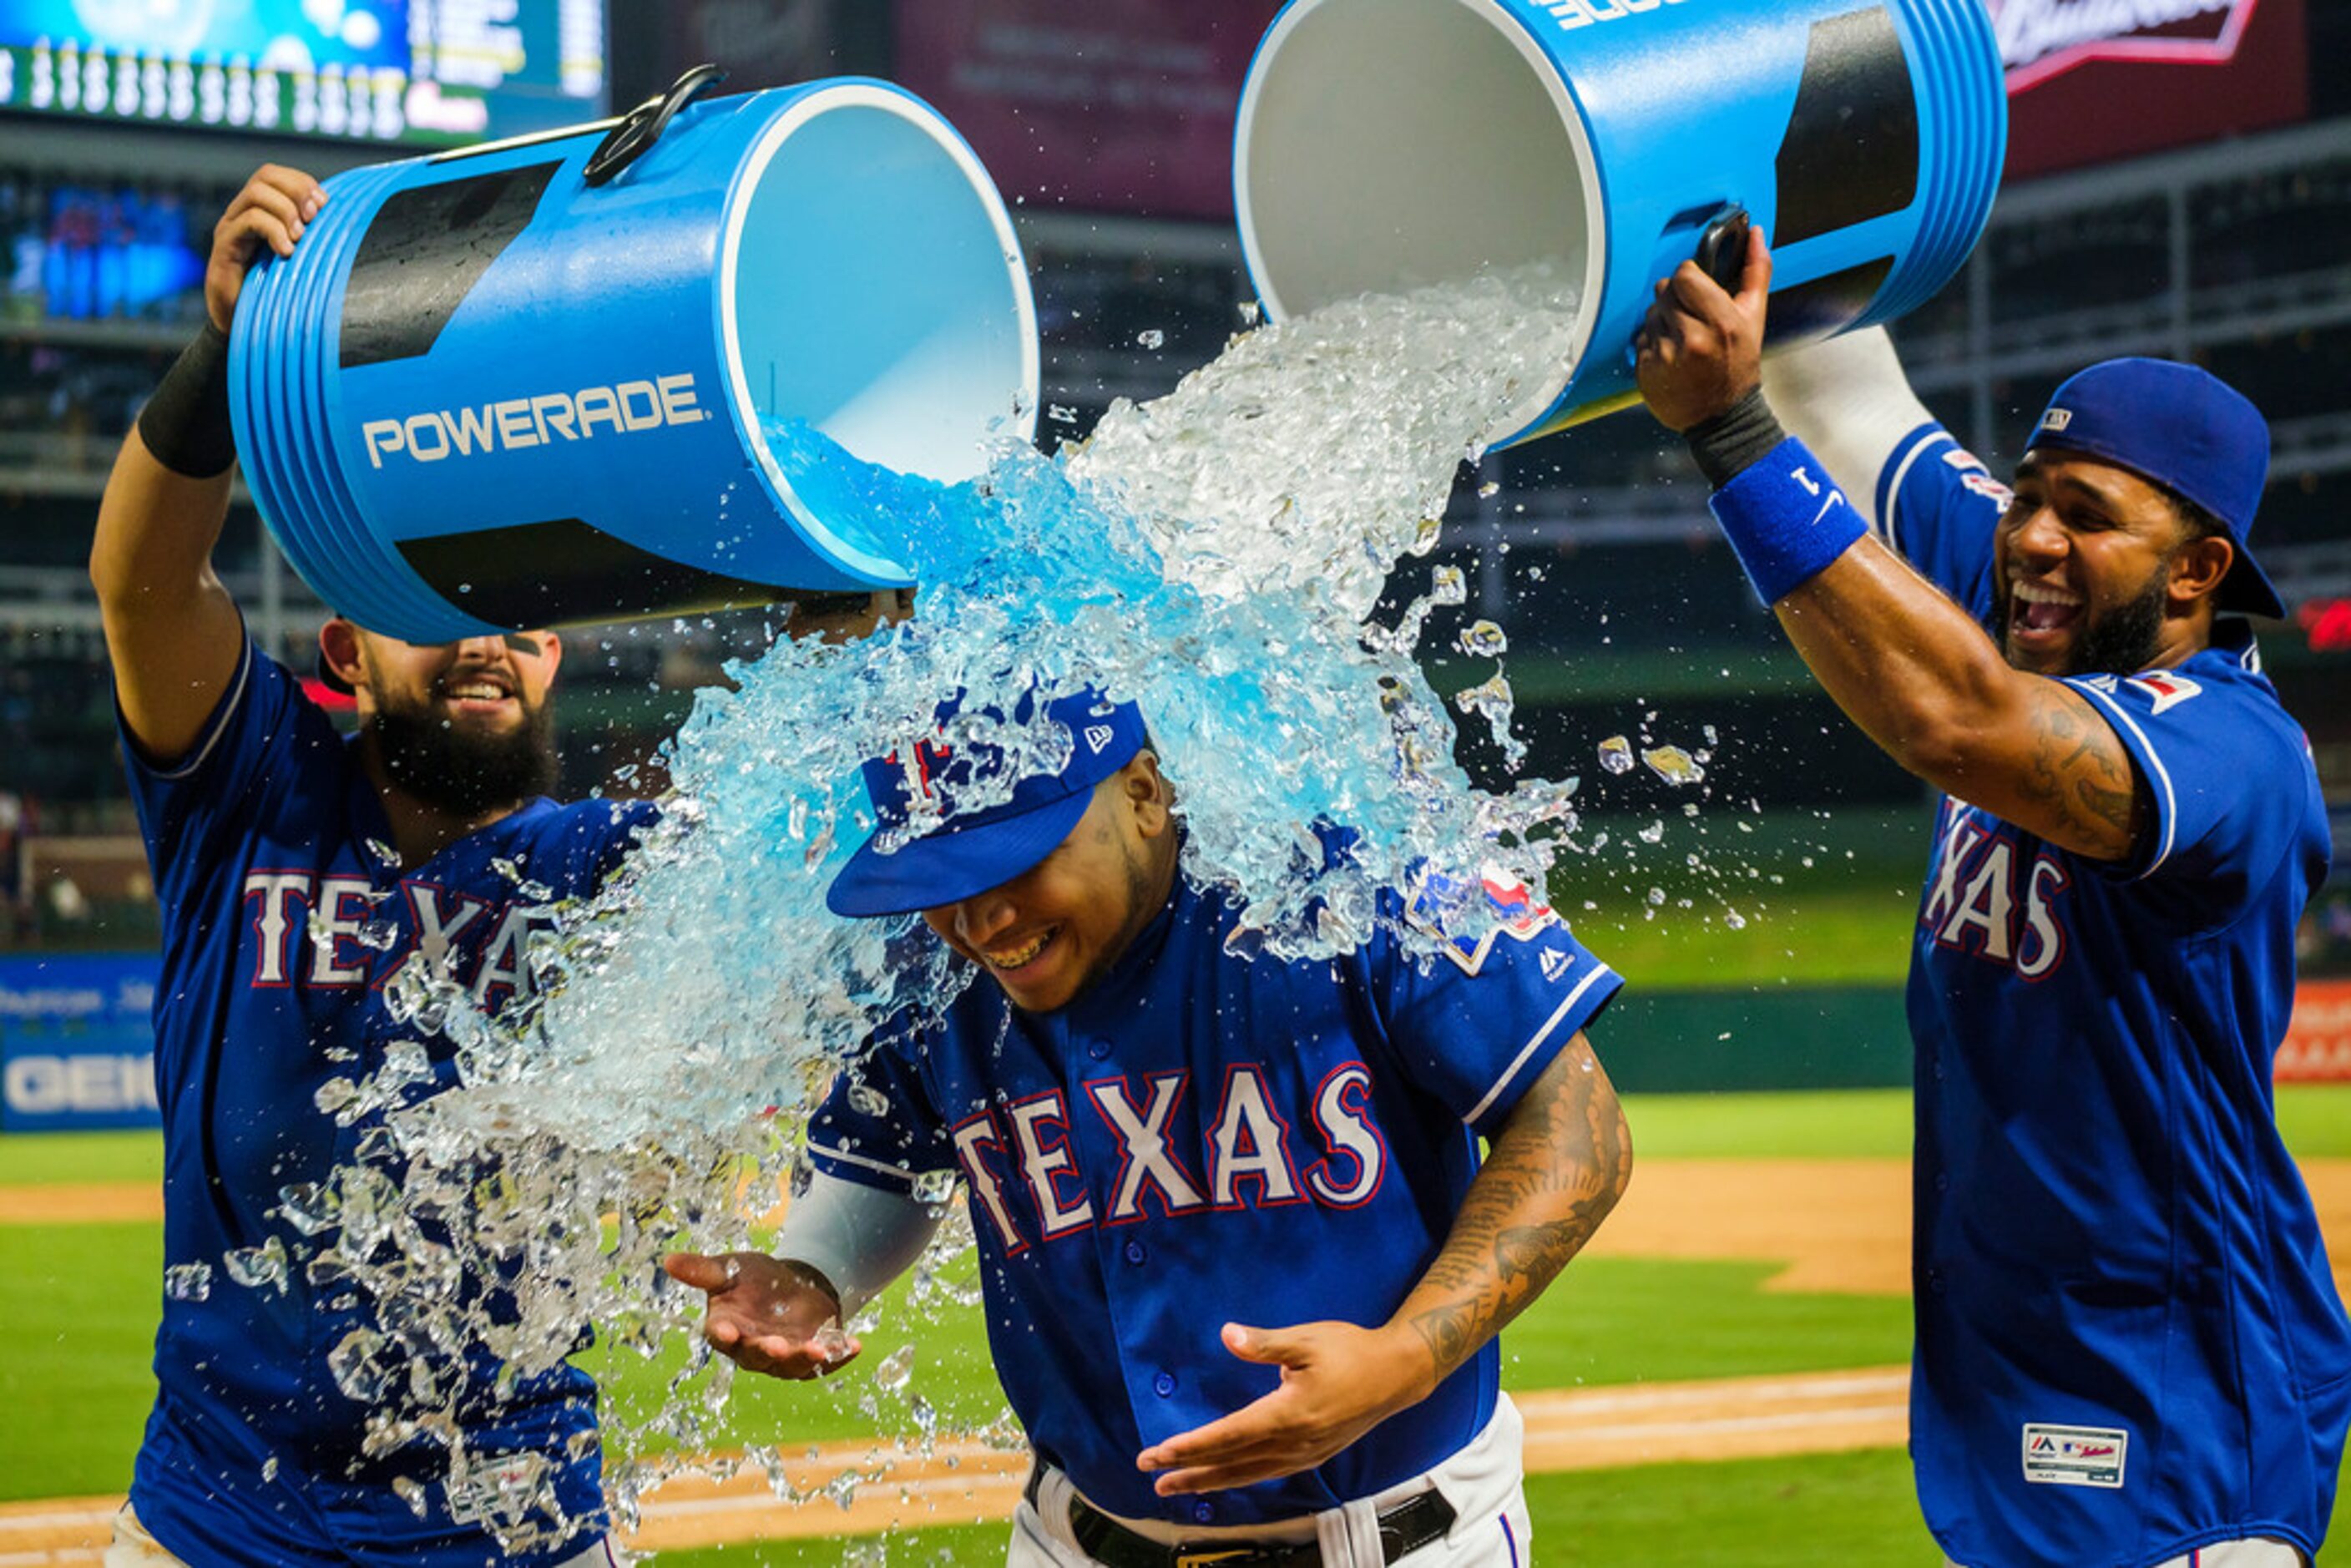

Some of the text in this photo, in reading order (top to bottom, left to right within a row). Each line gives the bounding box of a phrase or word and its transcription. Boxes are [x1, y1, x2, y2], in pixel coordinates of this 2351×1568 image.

[362, 372, 704, 469] POWERADE
[243, 867, 543, 1014] TEXA
[1920, 794, 2071, 984] XAS
[5, 1053, 159, 1115] GEI
[952, 1060, 1387, 1257] TEXAS
